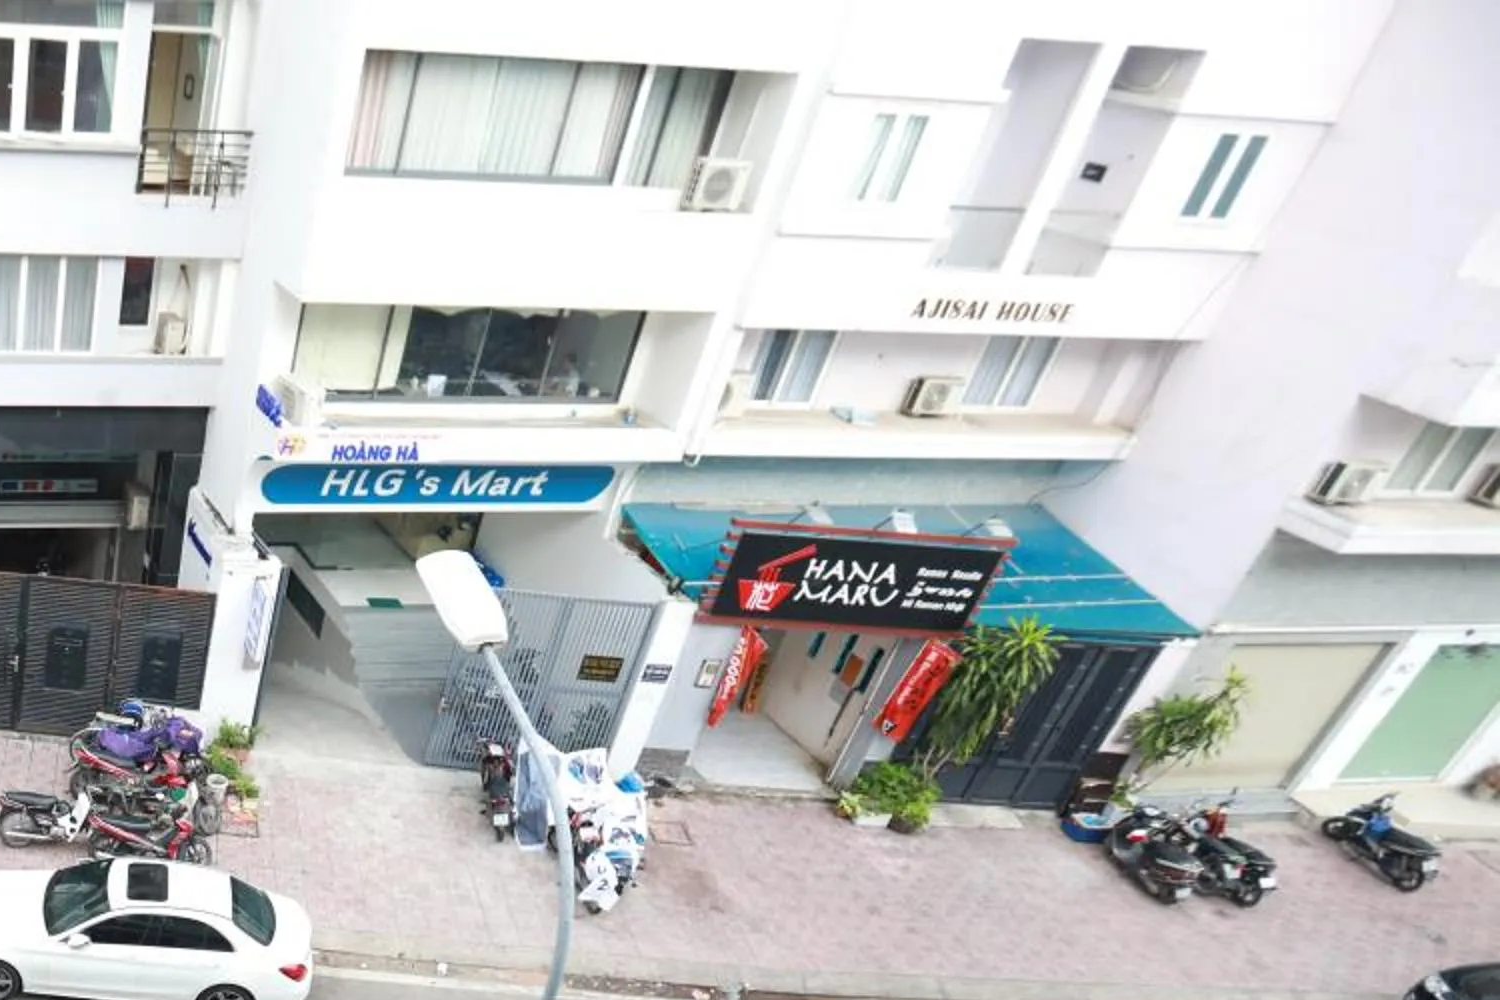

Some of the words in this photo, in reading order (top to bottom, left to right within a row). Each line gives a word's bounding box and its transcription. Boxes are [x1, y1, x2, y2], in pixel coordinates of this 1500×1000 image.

[911, 298, 989, 321] AJISAI
[996, 301, 1076, 324] HOUSE
[450, 470, 549, 497] Mart
[804, 558, 896, 585] HANA
[792, 581, 899, 607] MARU
